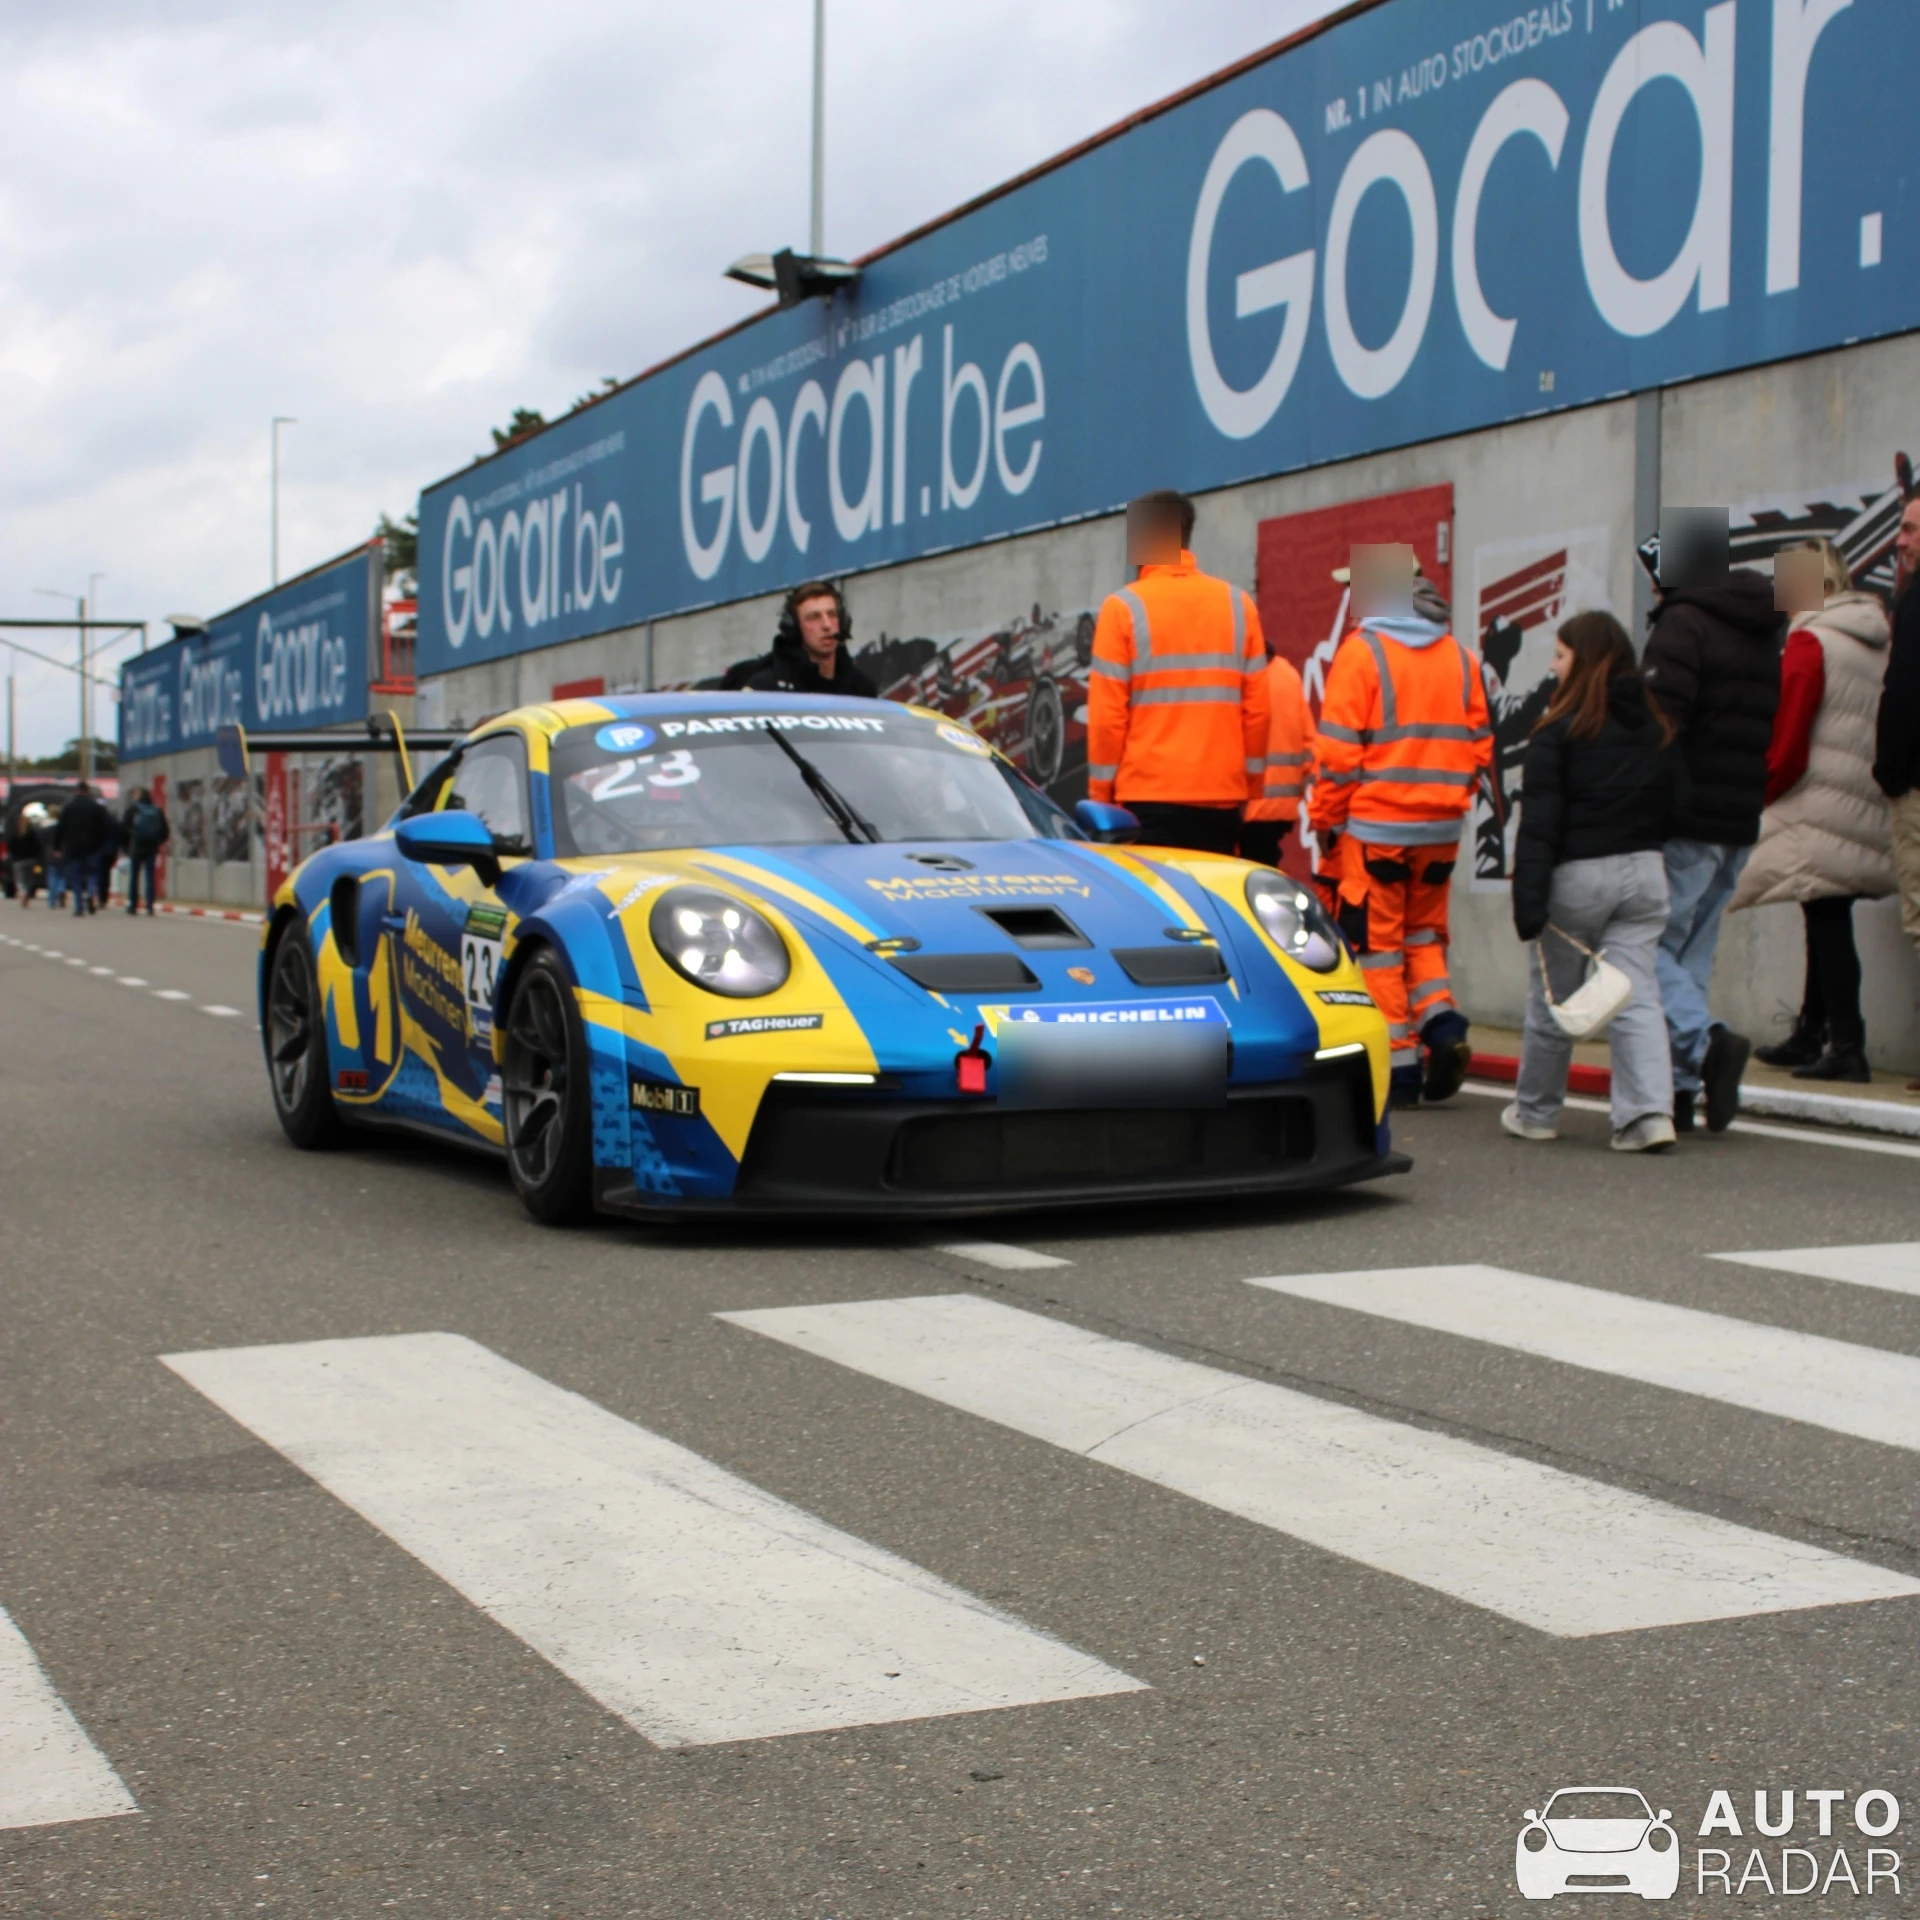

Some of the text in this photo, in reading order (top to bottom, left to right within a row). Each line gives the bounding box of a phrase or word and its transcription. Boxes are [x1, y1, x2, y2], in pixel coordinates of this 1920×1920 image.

[1325, 0, 1573, 133] NR. 1 IN AUTO STOCKDEALS
[681, 324, 1046, 580] Gocar.be
[443, 482, 624, 648] Gocar.be
[582, 750, 701, 802] 23
[866, 874, 1079, 890] Meurrens
[882, 885, 1090, 901] Machinery
[466, 941, 494, 1005] 23
[1057, 1006, 1207, 1023] MICHELIN
[632, 1082, 674, 1112] Mobil
